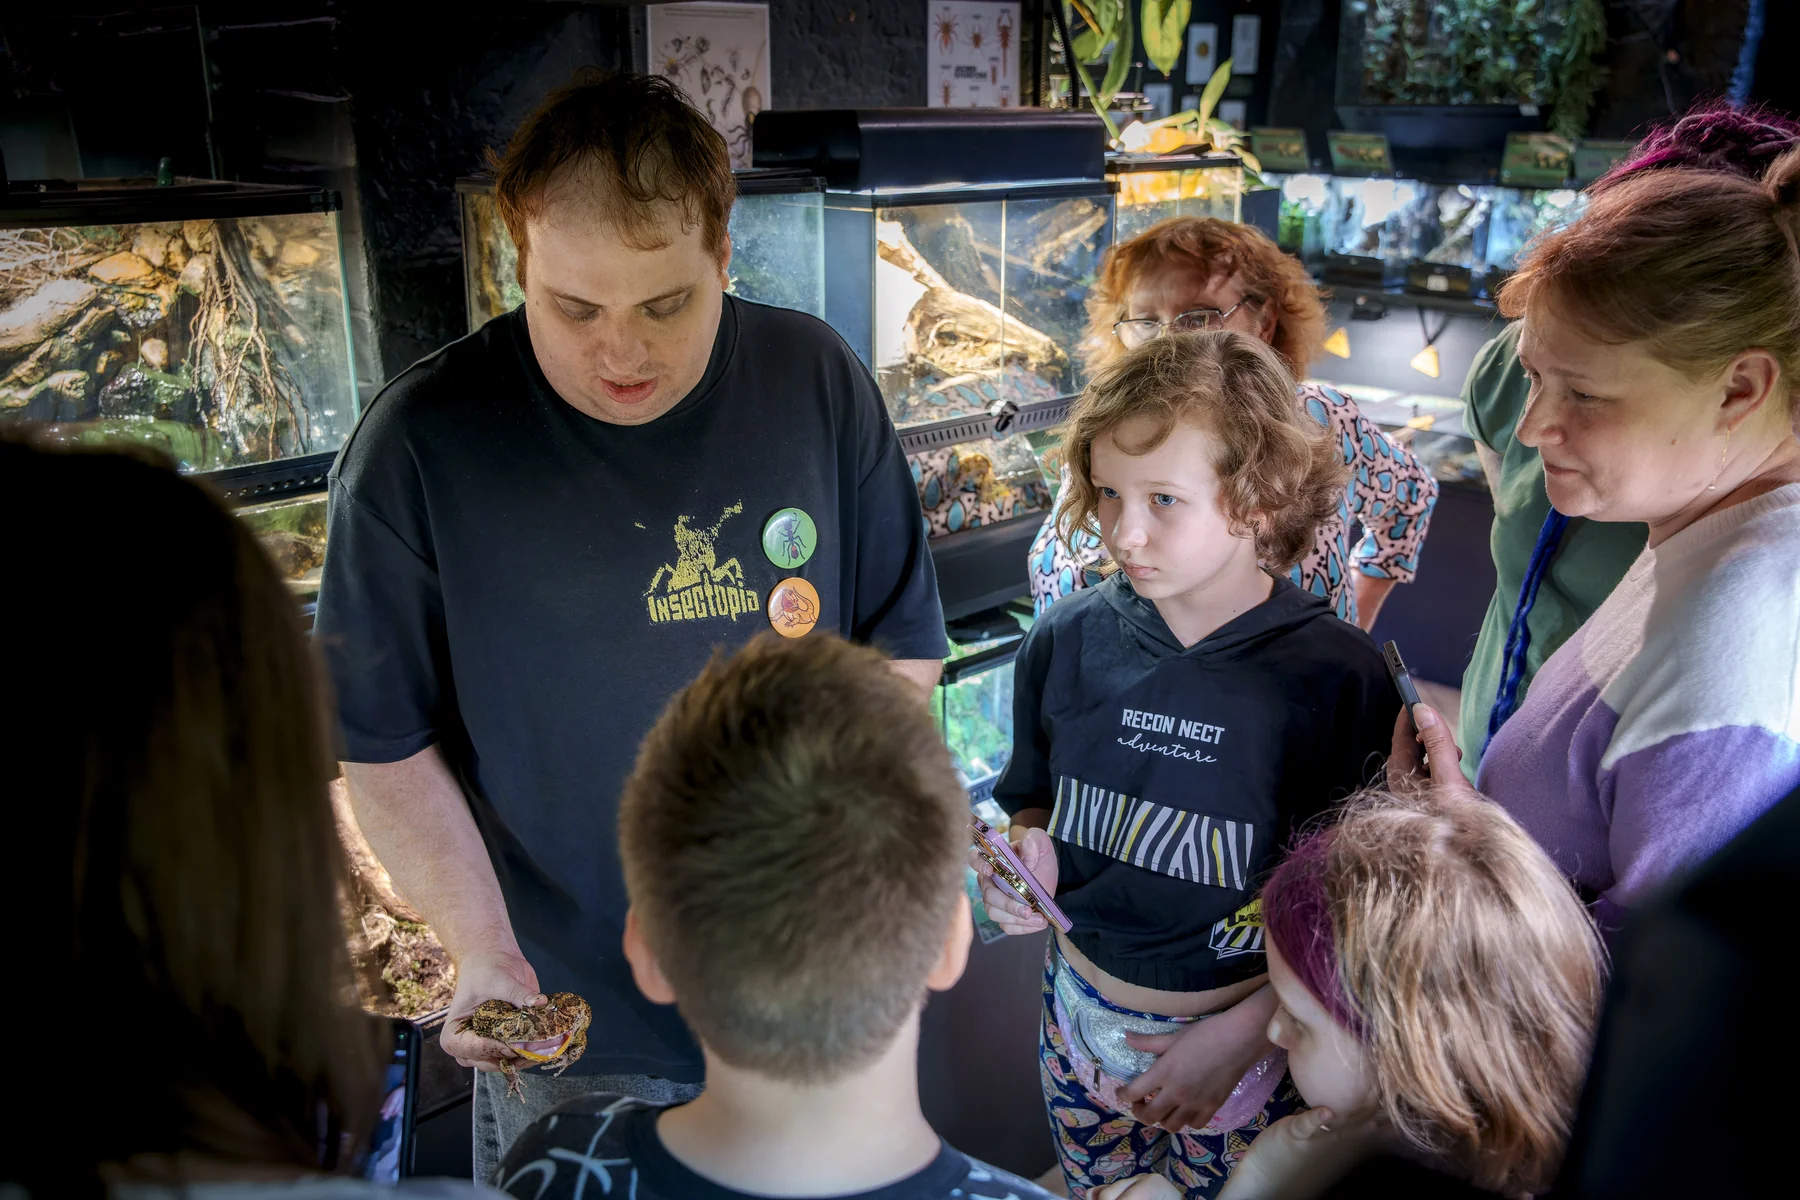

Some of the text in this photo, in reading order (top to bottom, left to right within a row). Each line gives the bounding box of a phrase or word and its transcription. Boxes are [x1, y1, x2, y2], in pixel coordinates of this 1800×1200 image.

[1121, 708, 1225, 744] RECON NECT
[1117, 732, 1217, 763] adventure
